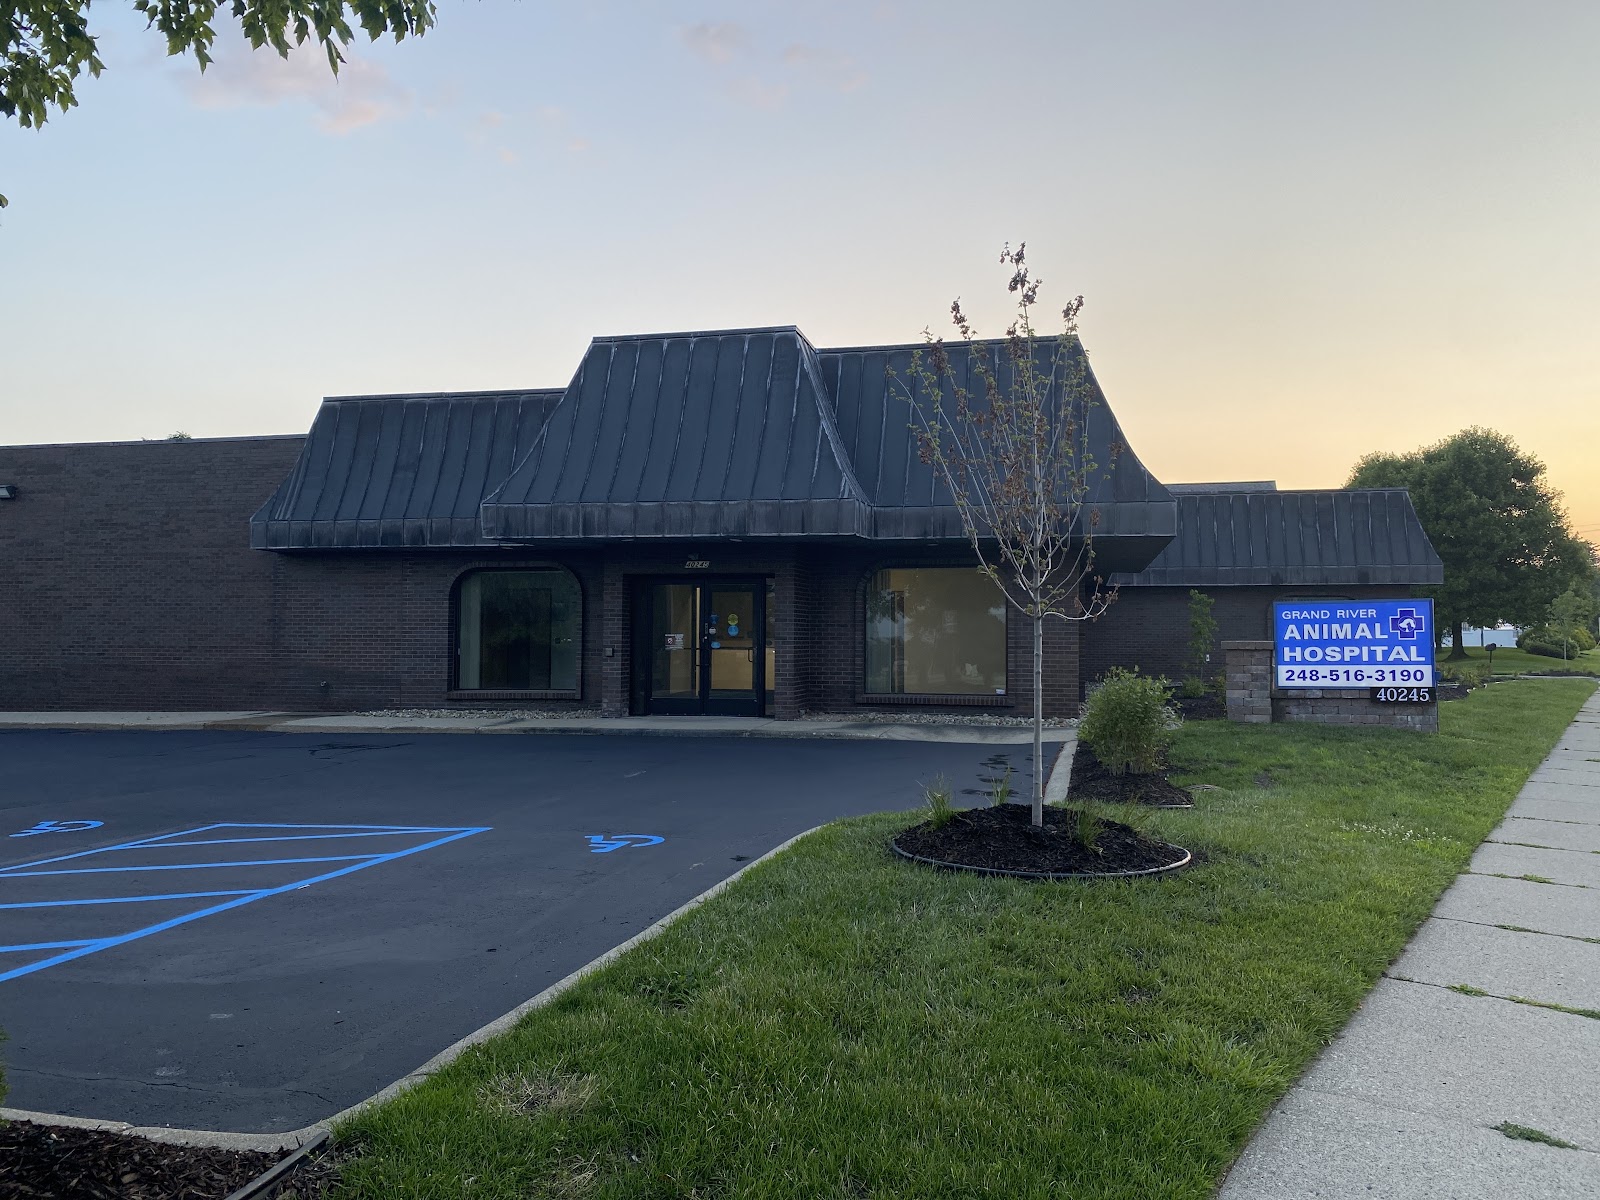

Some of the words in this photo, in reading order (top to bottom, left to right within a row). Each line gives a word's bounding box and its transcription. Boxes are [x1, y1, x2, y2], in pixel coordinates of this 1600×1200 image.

[1282, 610, 1330, 619] GRAND
[1336, 609, 1377, 618] RIVER
[1284, 623, 1388, 640] ANIMAL
[1283, 646, 1425, 662] HOSPITAL
[1285, 669, 1424, 682] 248-516-3190
[1376, 688, 1430, 702] 40245
